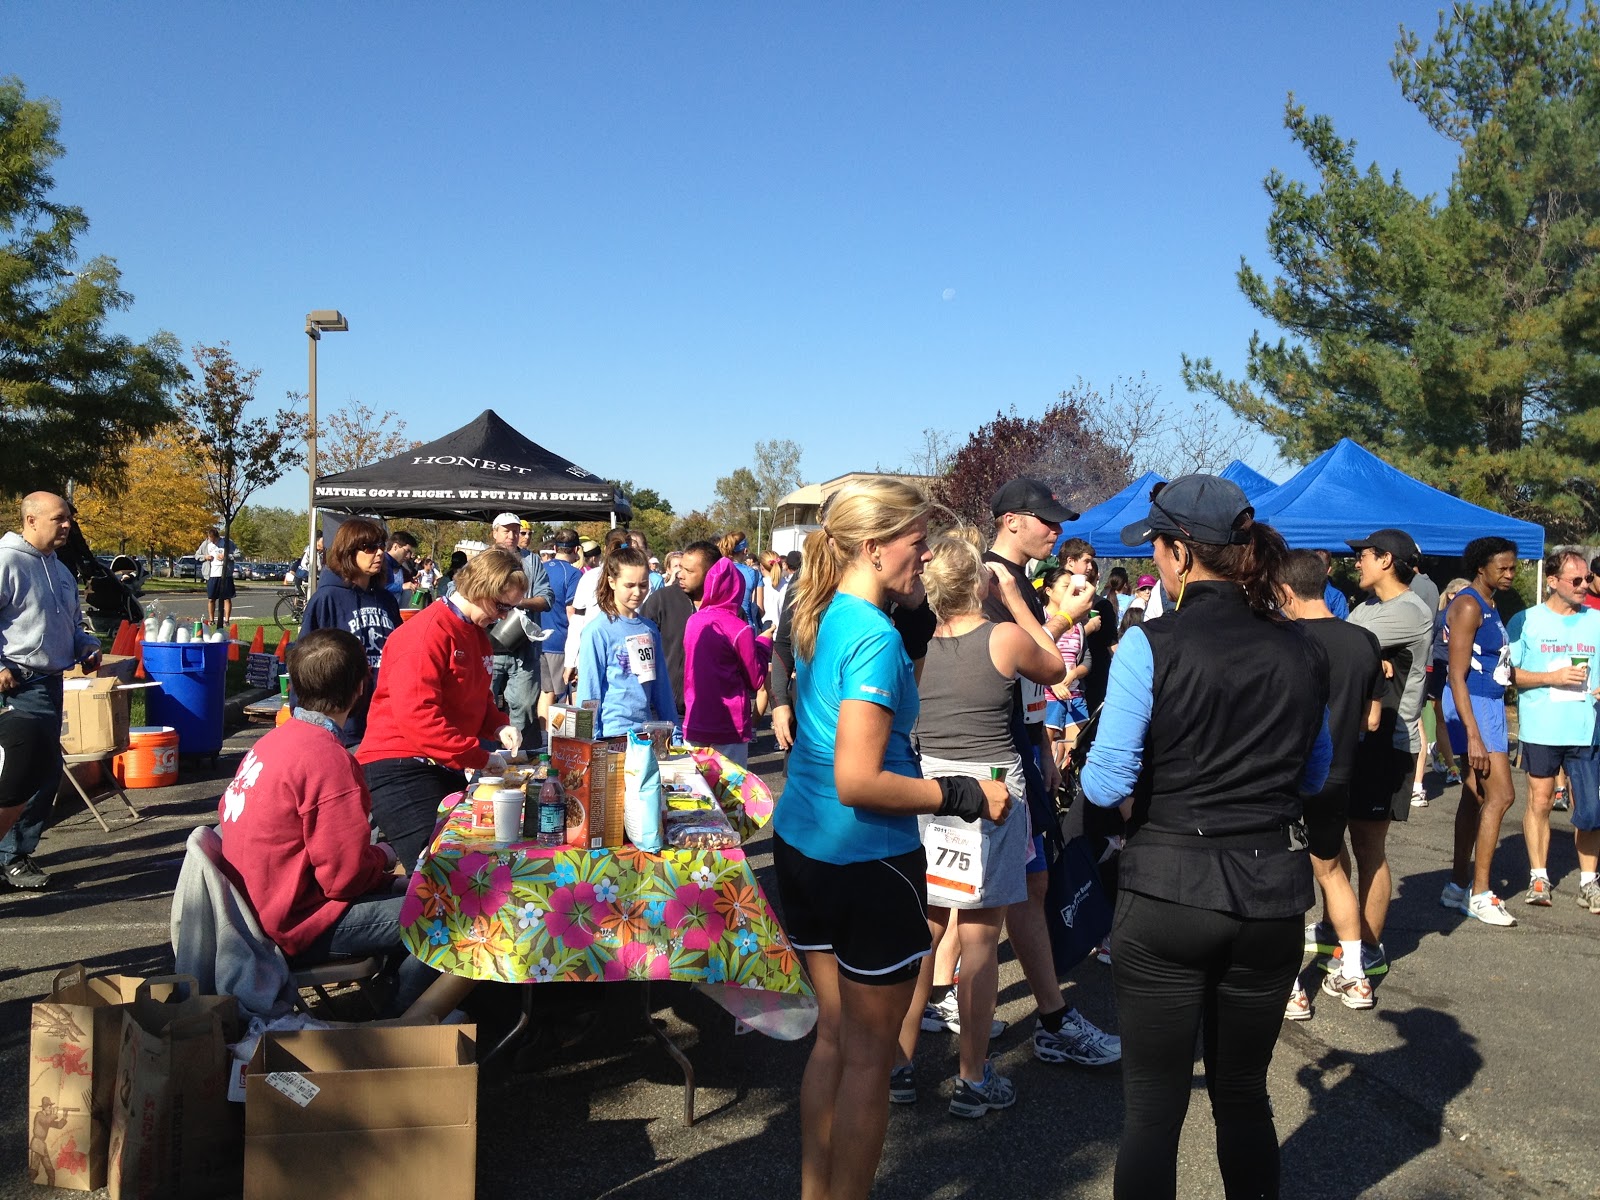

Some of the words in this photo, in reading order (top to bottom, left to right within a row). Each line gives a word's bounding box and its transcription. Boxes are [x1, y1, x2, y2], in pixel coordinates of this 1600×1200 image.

[411, 455, 532, 475] HONEST
[315, 487, 366, 497] NATURE
[368, 488, 395, 498] GOT
[397, 489, 410, 498] IT
[411, 489, 456, 499] RIGHT.
[459, 490, 479, 499] WE
[480, 490, 506, 500] PUT
[507, 491, 521, 500] IT
[523, 491, 537, 500] IN
[538, 492, 550, 501] A
[352, 606, 382, 618] POPERTY
[638, 647, 654, 661] 367
[1541, 643, 1573, 653] Brian's
[1576, 642, 1596, 653] Run
[935, 846, 971, 872] 775
